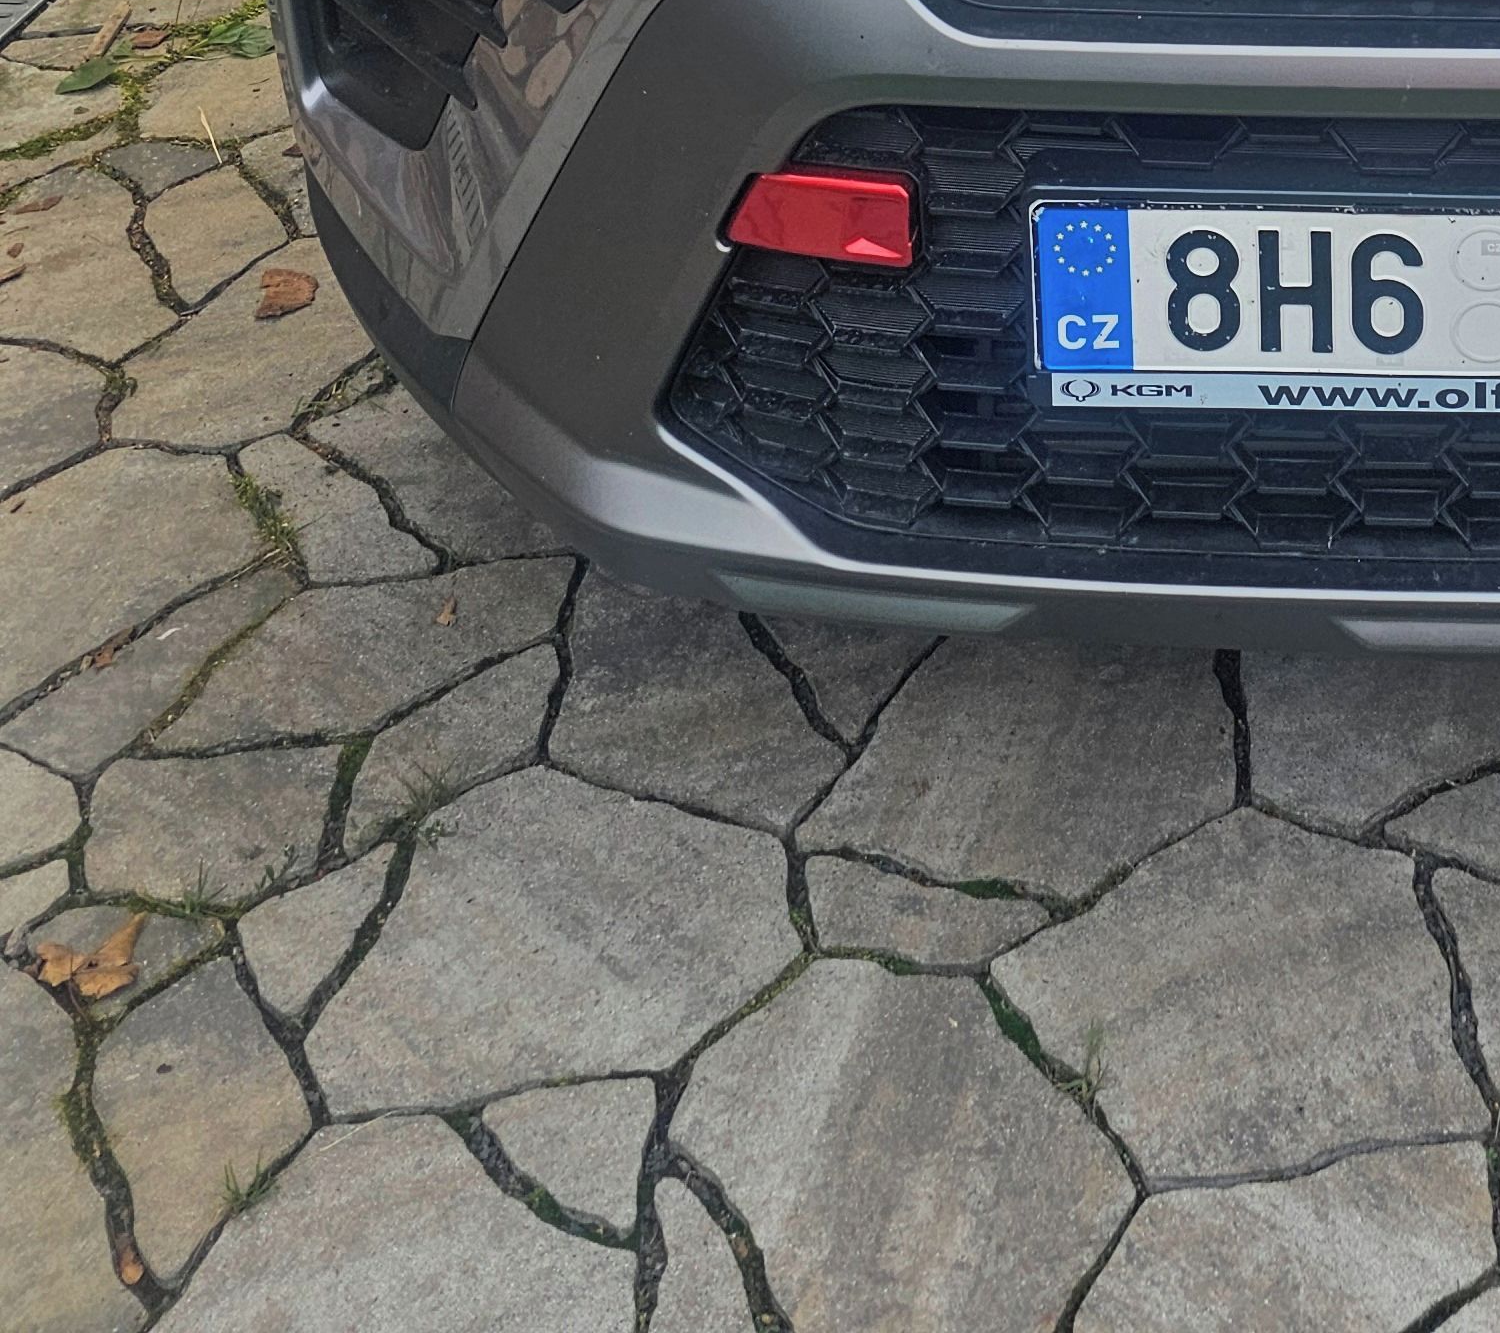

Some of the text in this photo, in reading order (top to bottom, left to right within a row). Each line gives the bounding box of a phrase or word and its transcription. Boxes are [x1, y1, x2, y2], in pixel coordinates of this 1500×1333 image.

[1166, 229, 1424, 355] 8H6
[1057, 314, 1120, 350] CZ
[1110, 384, 1193, 397] KGM
